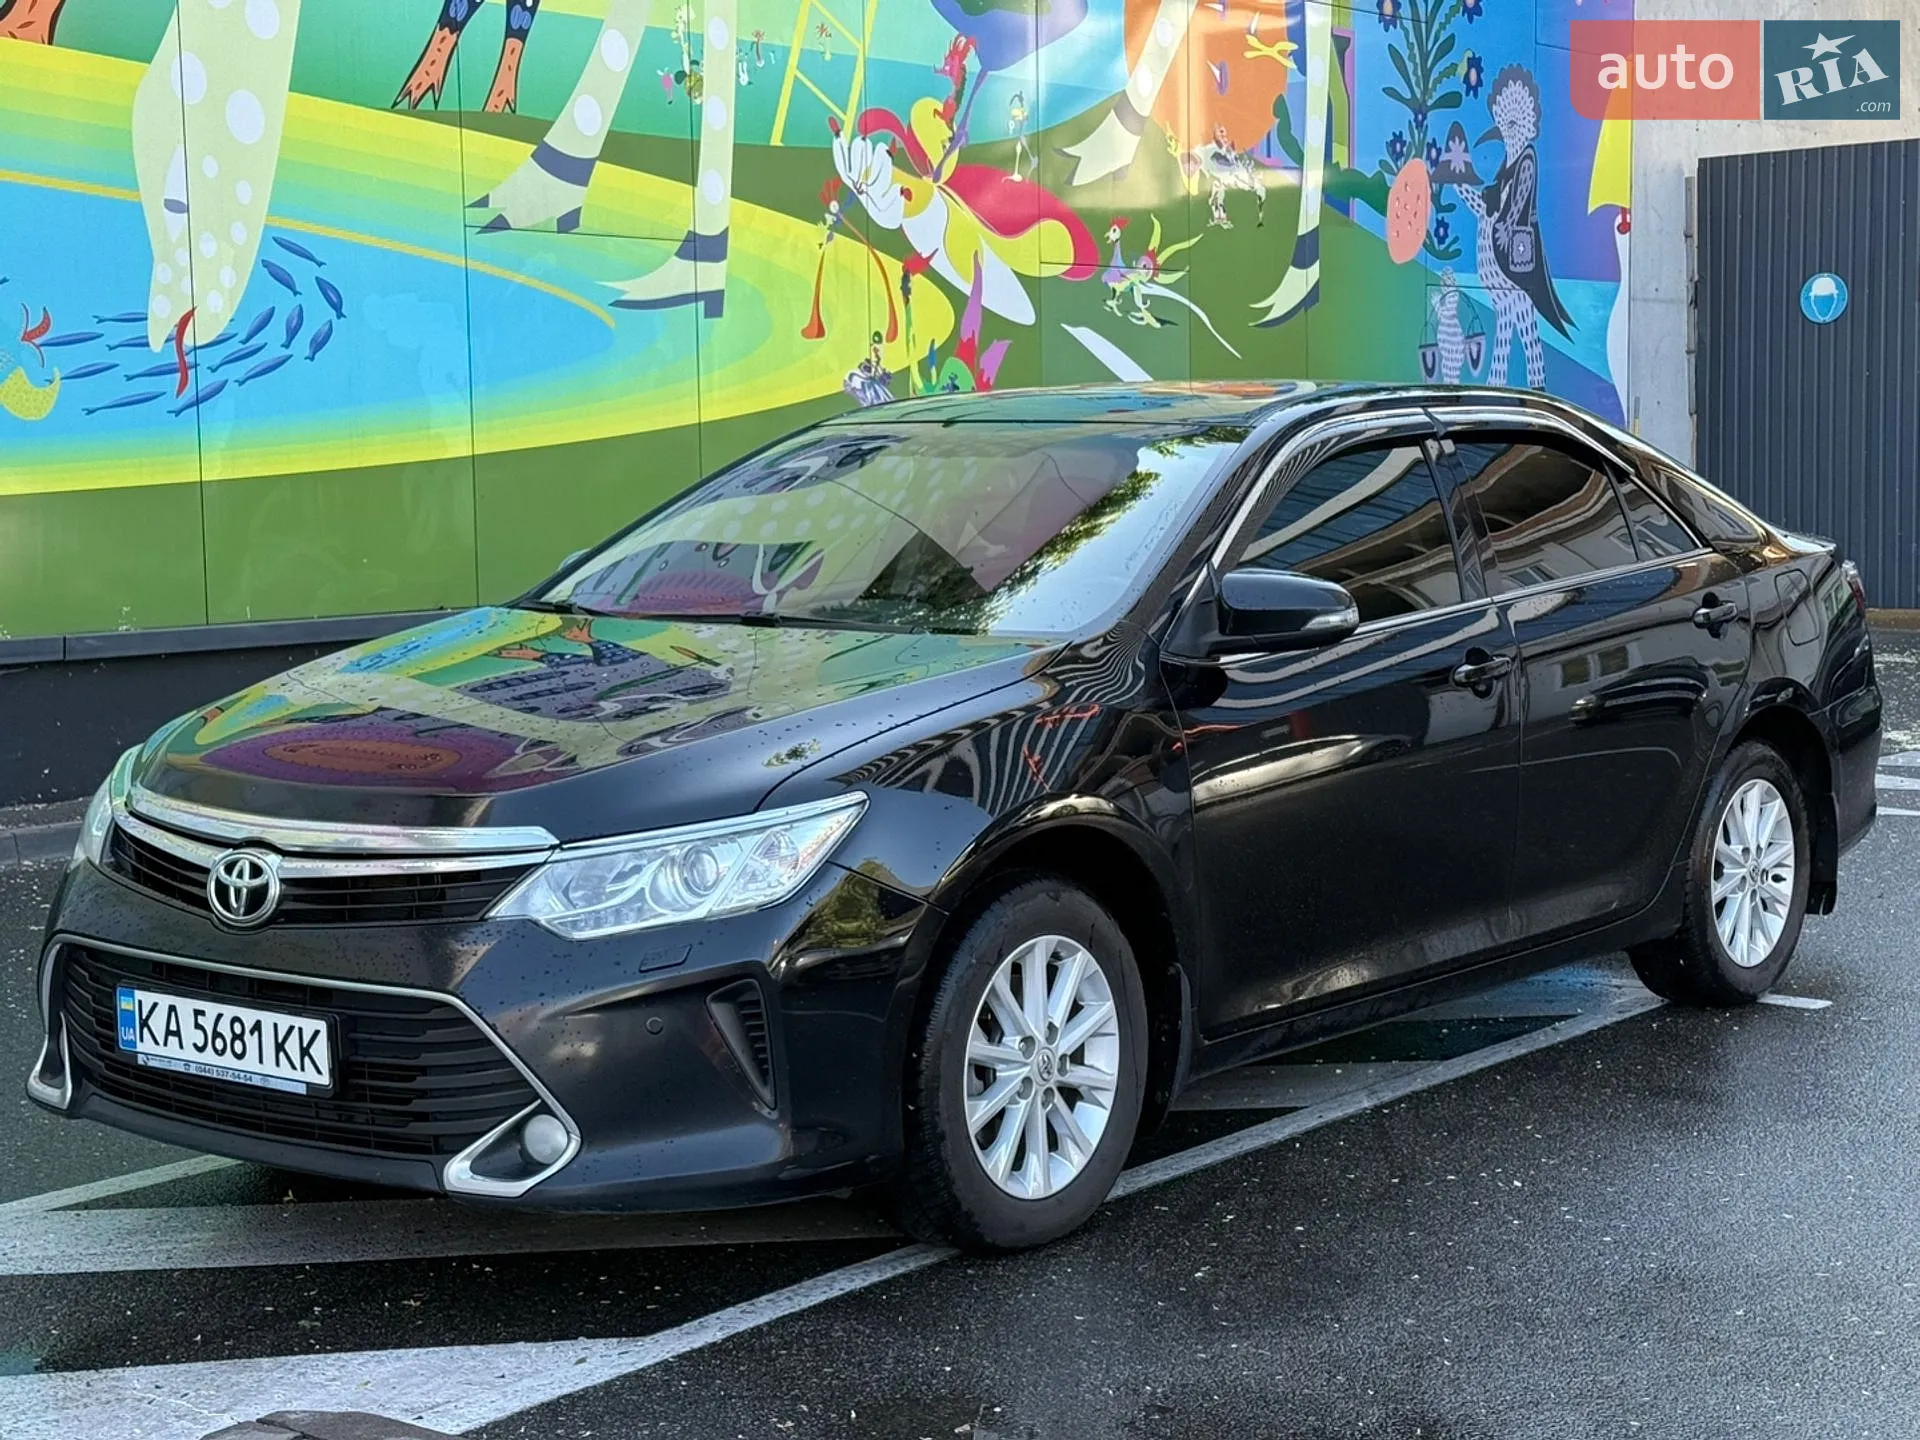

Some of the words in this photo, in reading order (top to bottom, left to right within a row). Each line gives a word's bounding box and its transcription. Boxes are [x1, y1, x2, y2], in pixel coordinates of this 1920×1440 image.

[121, 1026, 136, 1042] UA
[137, 998, 184, 1050] KA
[192, 1008, 264, 1065] 5681
[273, 1021, 324, 1076] KK
